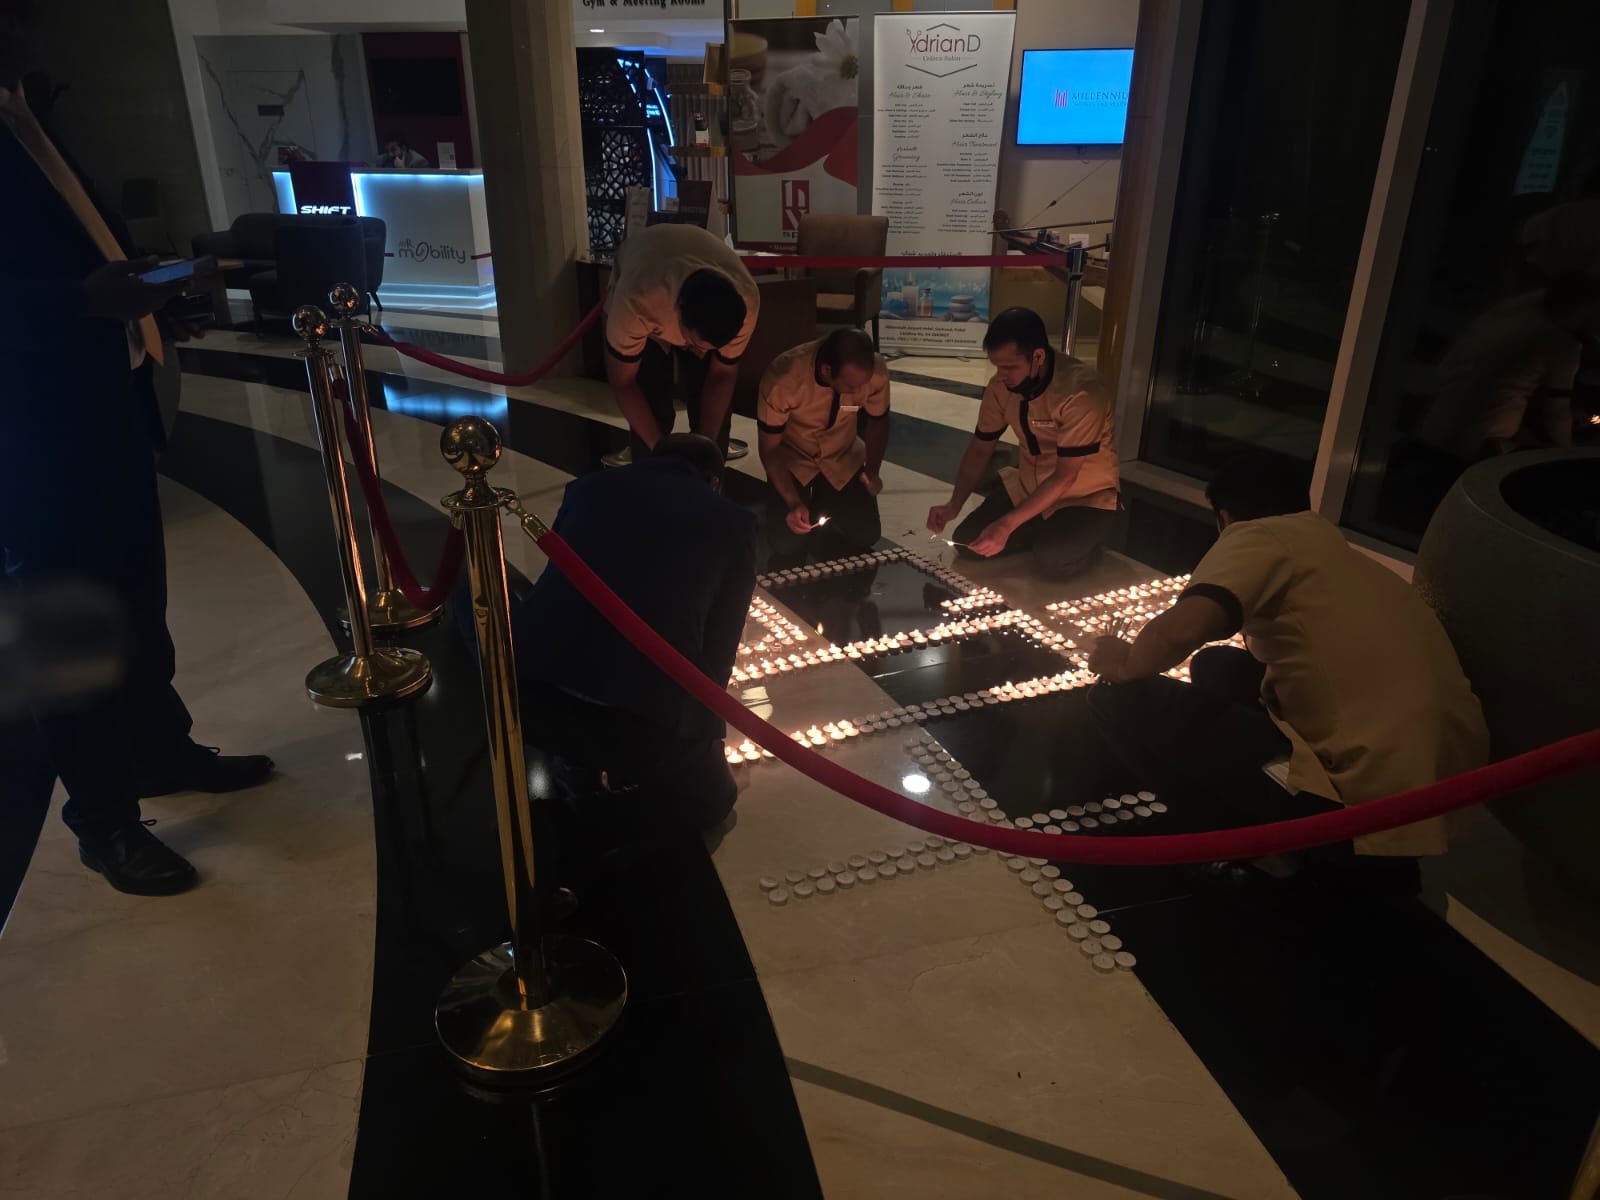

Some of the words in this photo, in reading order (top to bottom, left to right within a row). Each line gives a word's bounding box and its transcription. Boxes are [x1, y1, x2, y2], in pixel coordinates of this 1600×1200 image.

[583, 0, 605, 9] Gym
[623, 0, 667, 9] Meeting
[300, 205, 351, 215] SHIFT
